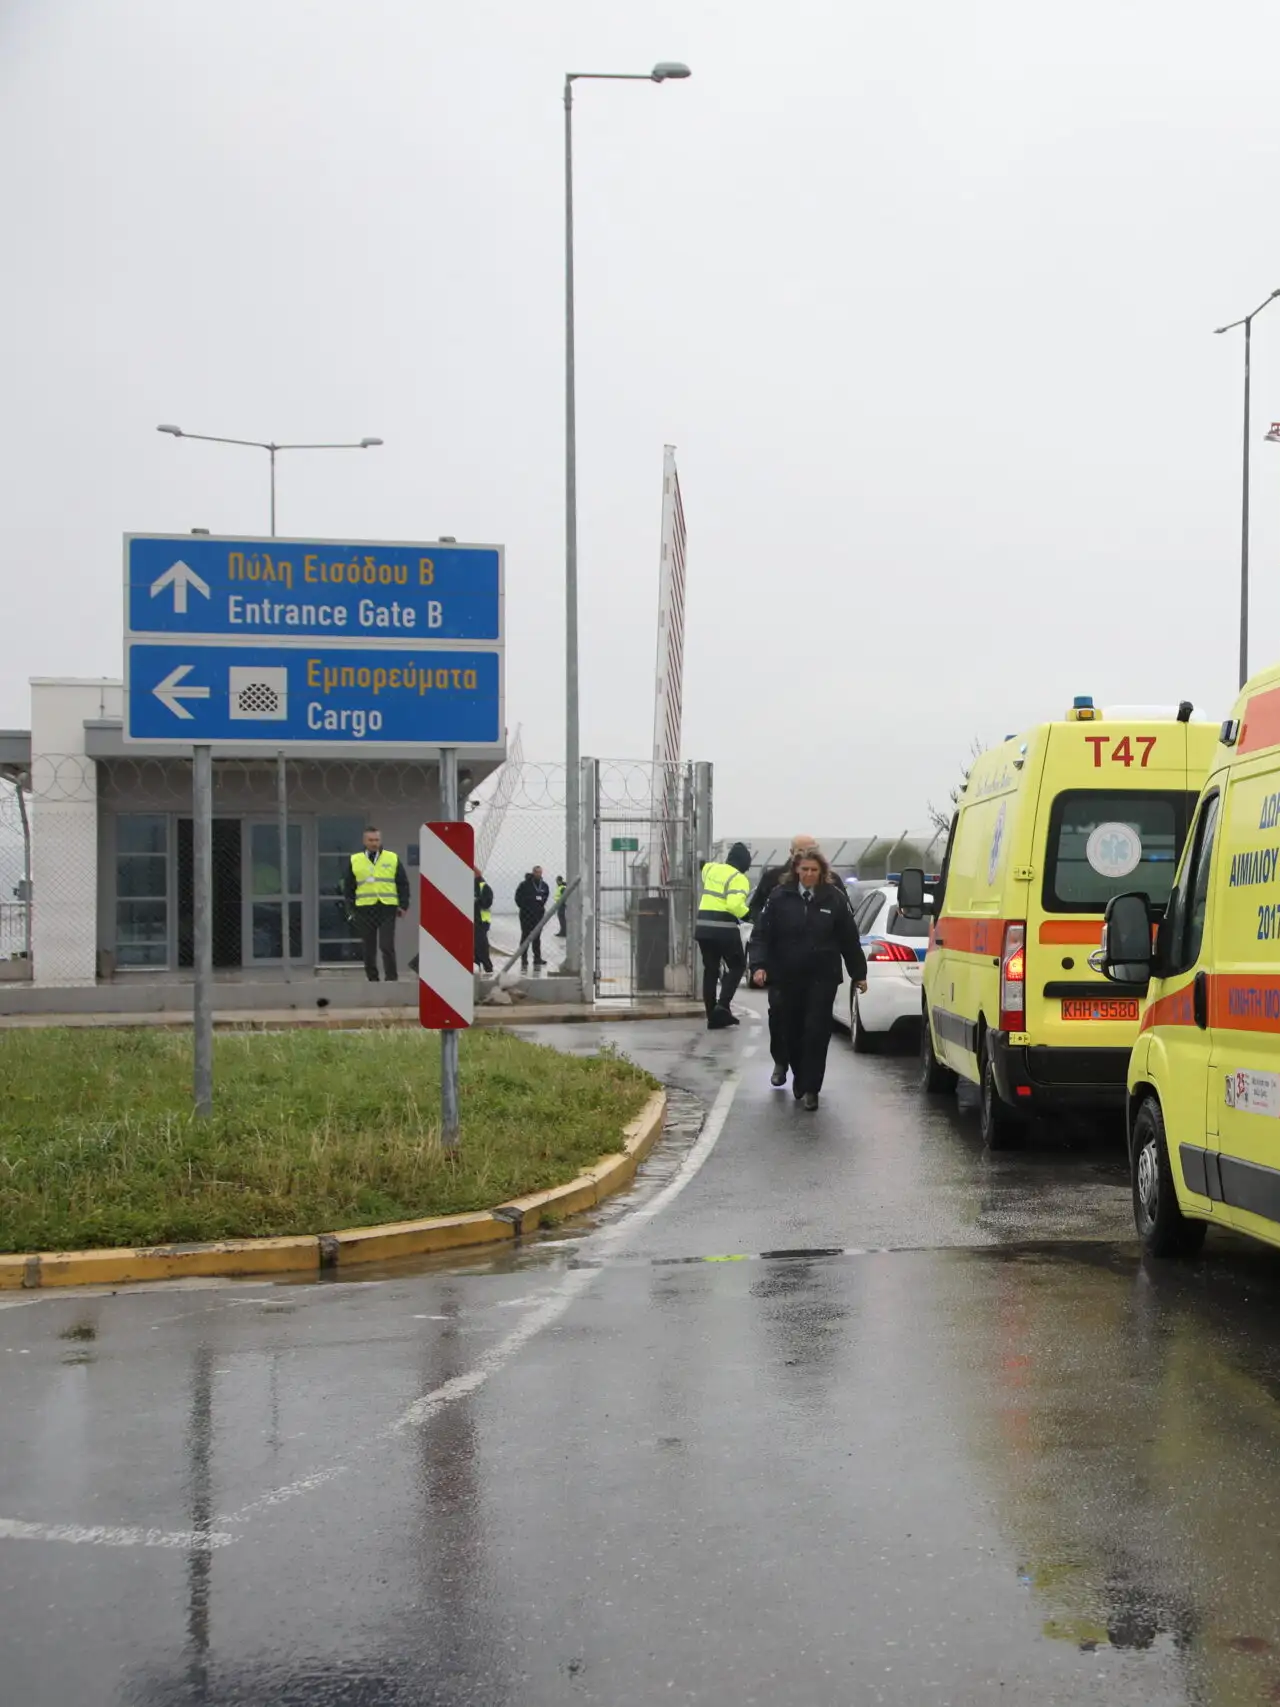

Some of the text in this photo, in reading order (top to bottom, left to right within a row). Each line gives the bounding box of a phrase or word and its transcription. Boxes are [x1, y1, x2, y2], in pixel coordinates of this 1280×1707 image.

[228, 552, 435, 590] Πύλη Εισόδου Β
[229, 595, 443, 628] Entrance Gate B
[307, 659, 477, 695] Εμπορεύματα
[307, 702, 383, 738] Cargo
[1084, 736, 1157, 768] T47
[1229, 847, 1280, 887] ΑΙΜΙΛΙΟΥ
